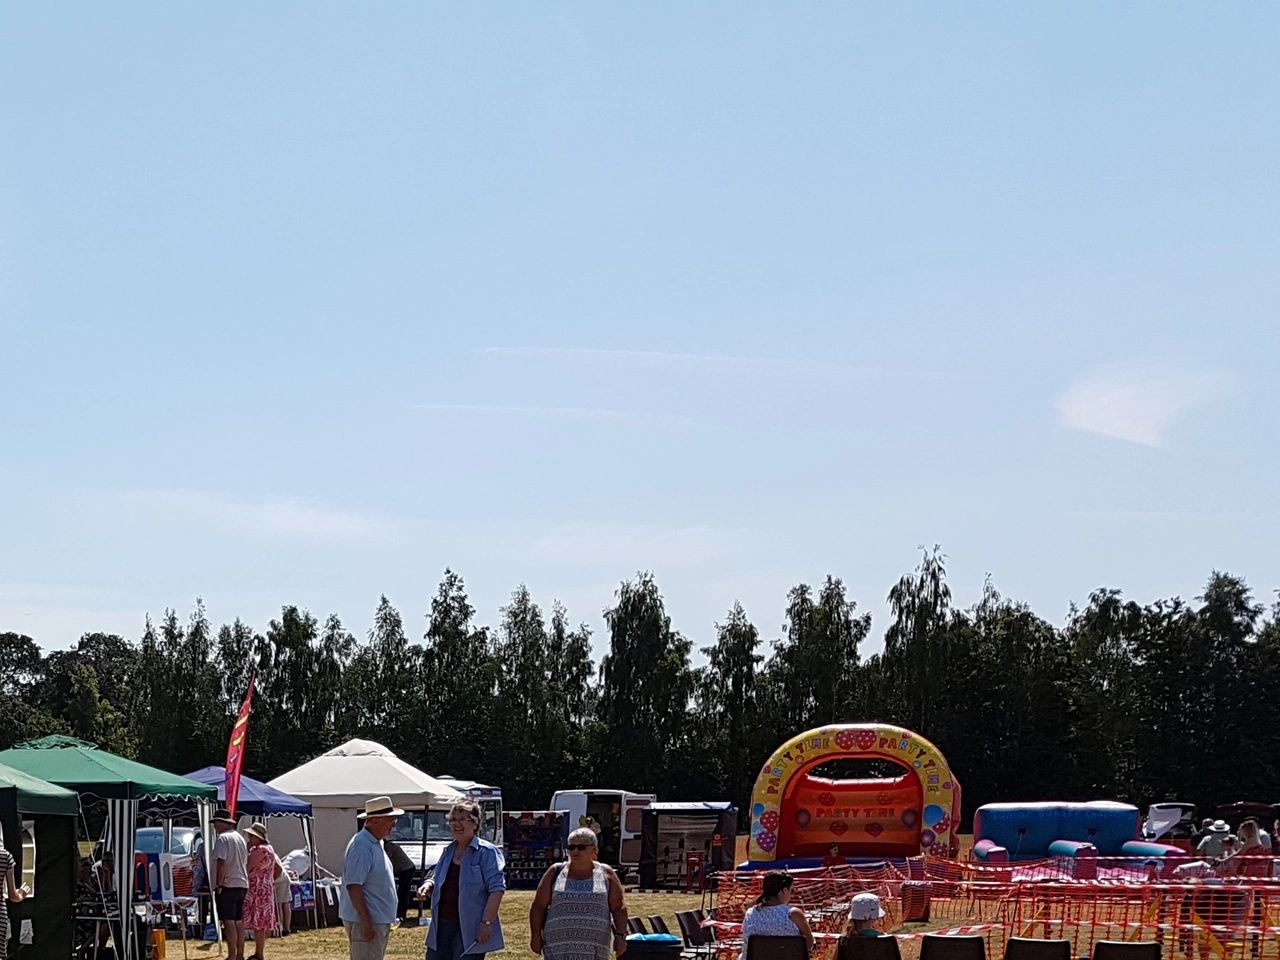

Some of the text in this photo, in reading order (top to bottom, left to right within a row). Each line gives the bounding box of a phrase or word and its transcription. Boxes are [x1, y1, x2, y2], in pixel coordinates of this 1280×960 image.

[767, 738, 830, 794] PARTY TIME
[879, 737, 940, 792] PARTY TIME
[816, 807, 895, 818] PARTY TIME
